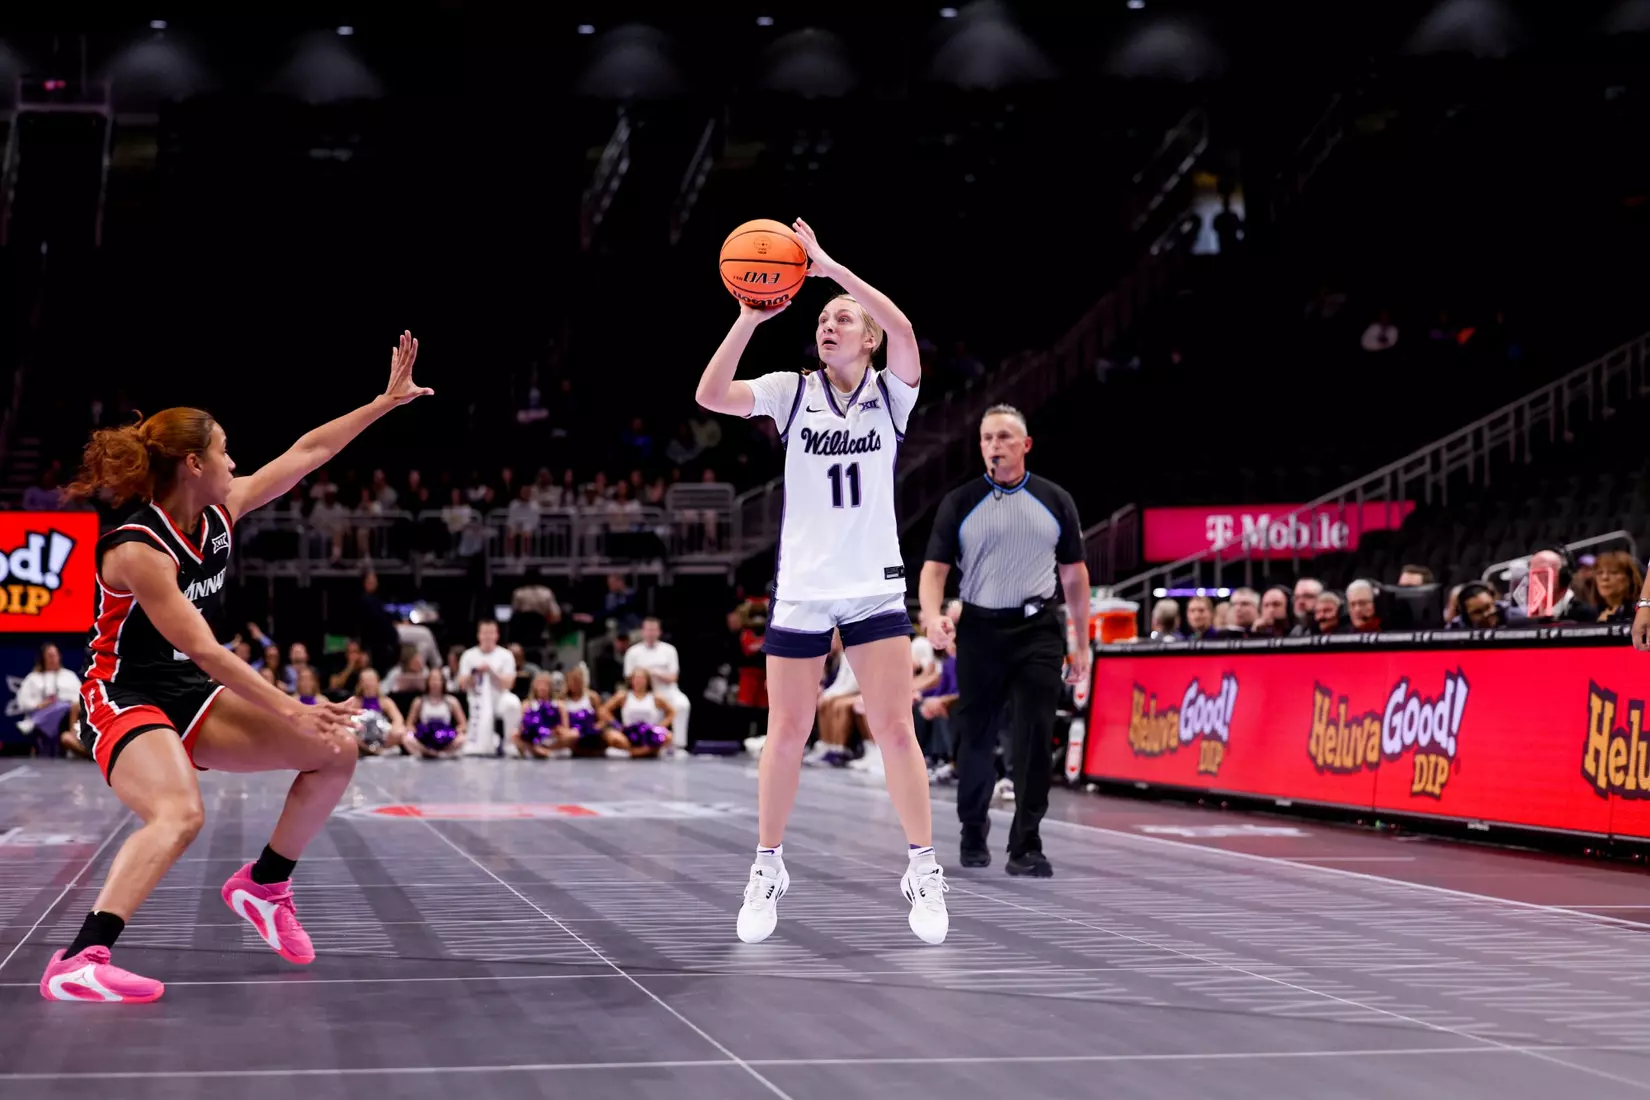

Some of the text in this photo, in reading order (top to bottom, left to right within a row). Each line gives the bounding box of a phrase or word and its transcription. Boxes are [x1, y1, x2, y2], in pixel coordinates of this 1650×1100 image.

[743, 271, 780, 284] EVO
[801, 427, 881, 456] Wildcats
[827, 462, 862, 508] 11
[1240, 512, 1350, 550] Moble
[1308, 675, 1469, 770] Heluva Good!
[1411, 752, 1450, 796] DIP
